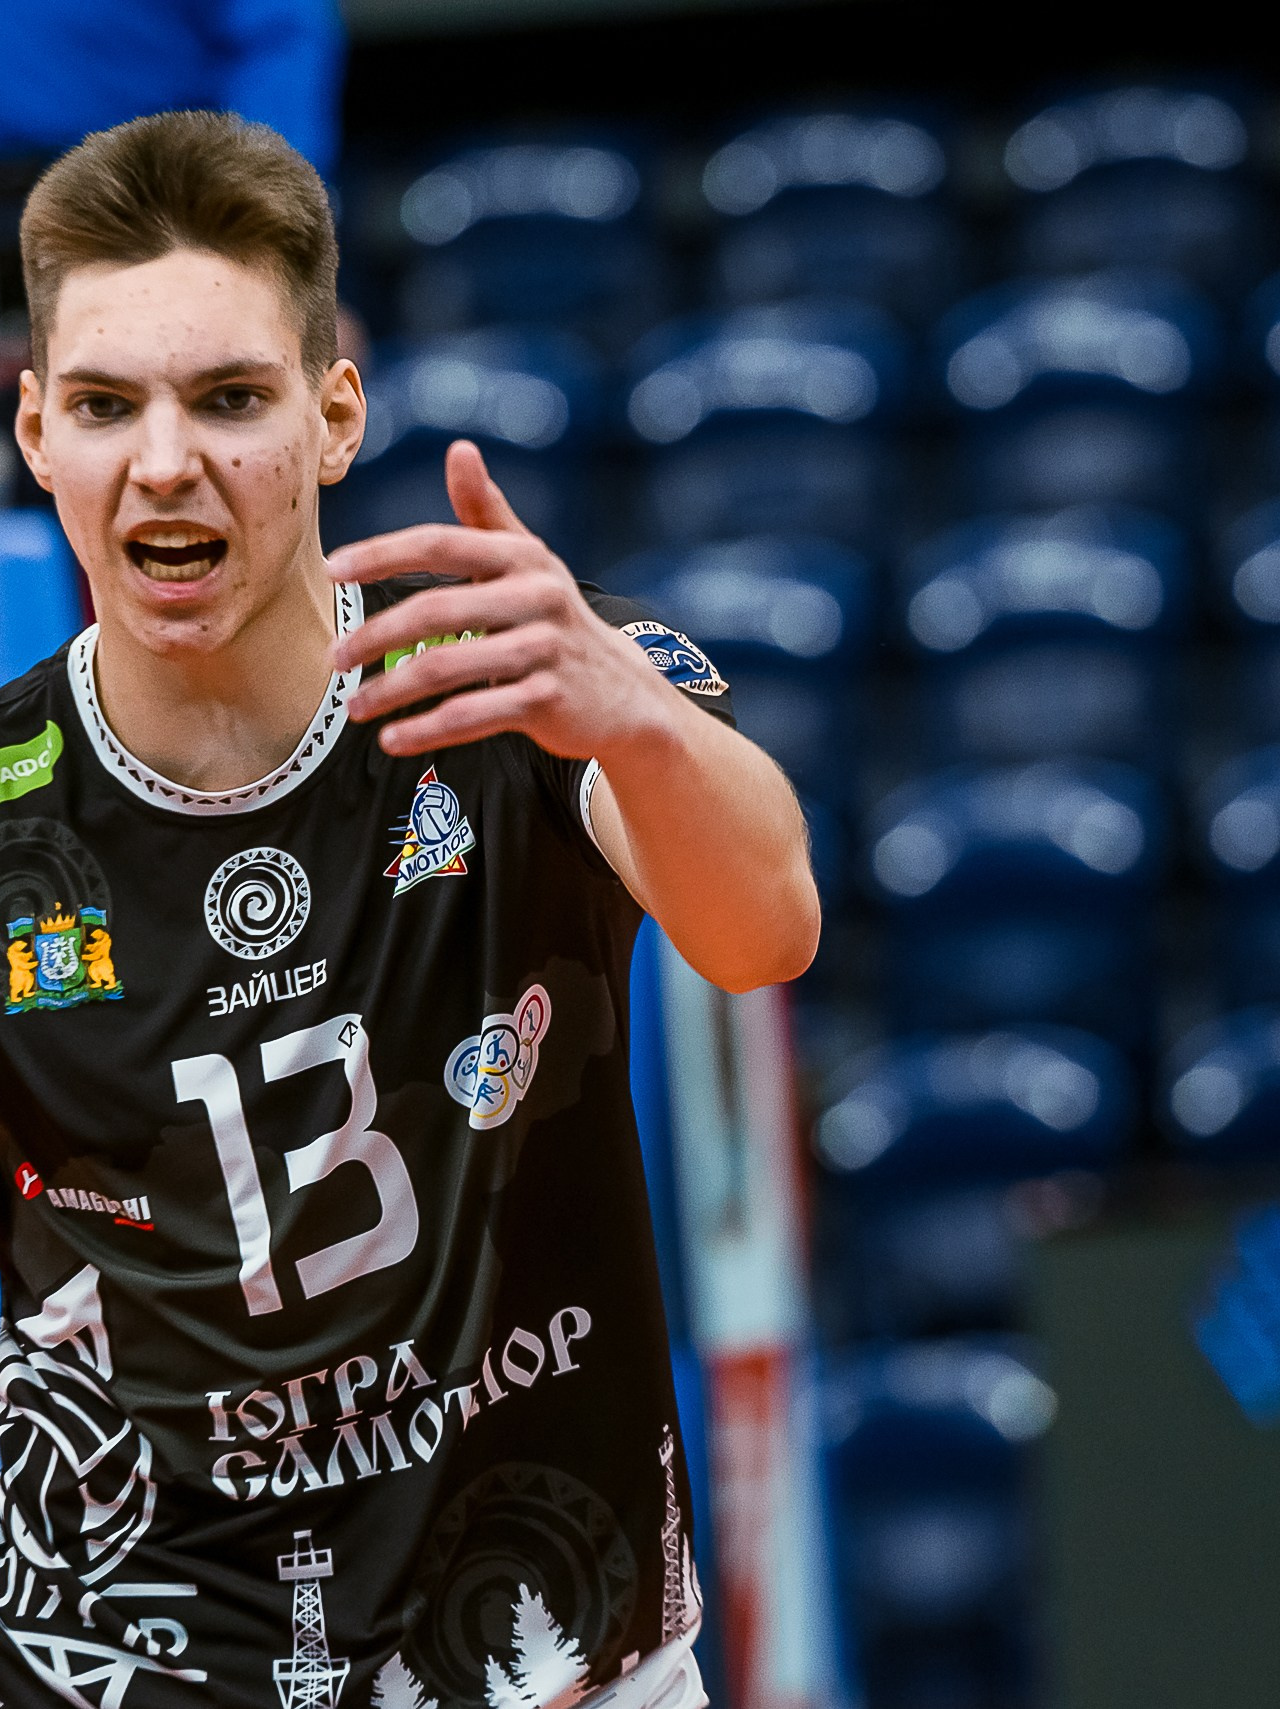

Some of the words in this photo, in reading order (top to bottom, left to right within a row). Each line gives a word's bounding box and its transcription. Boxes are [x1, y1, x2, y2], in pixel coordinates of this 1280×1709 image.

[396, 827, 471, 886] АМОТЛОР
[206, 958, 328, 1017] ЗАЙЦЕВ
[171, 1013, 419, 1317] 13
[205, 1339, 437, 1441] ЮГРА
